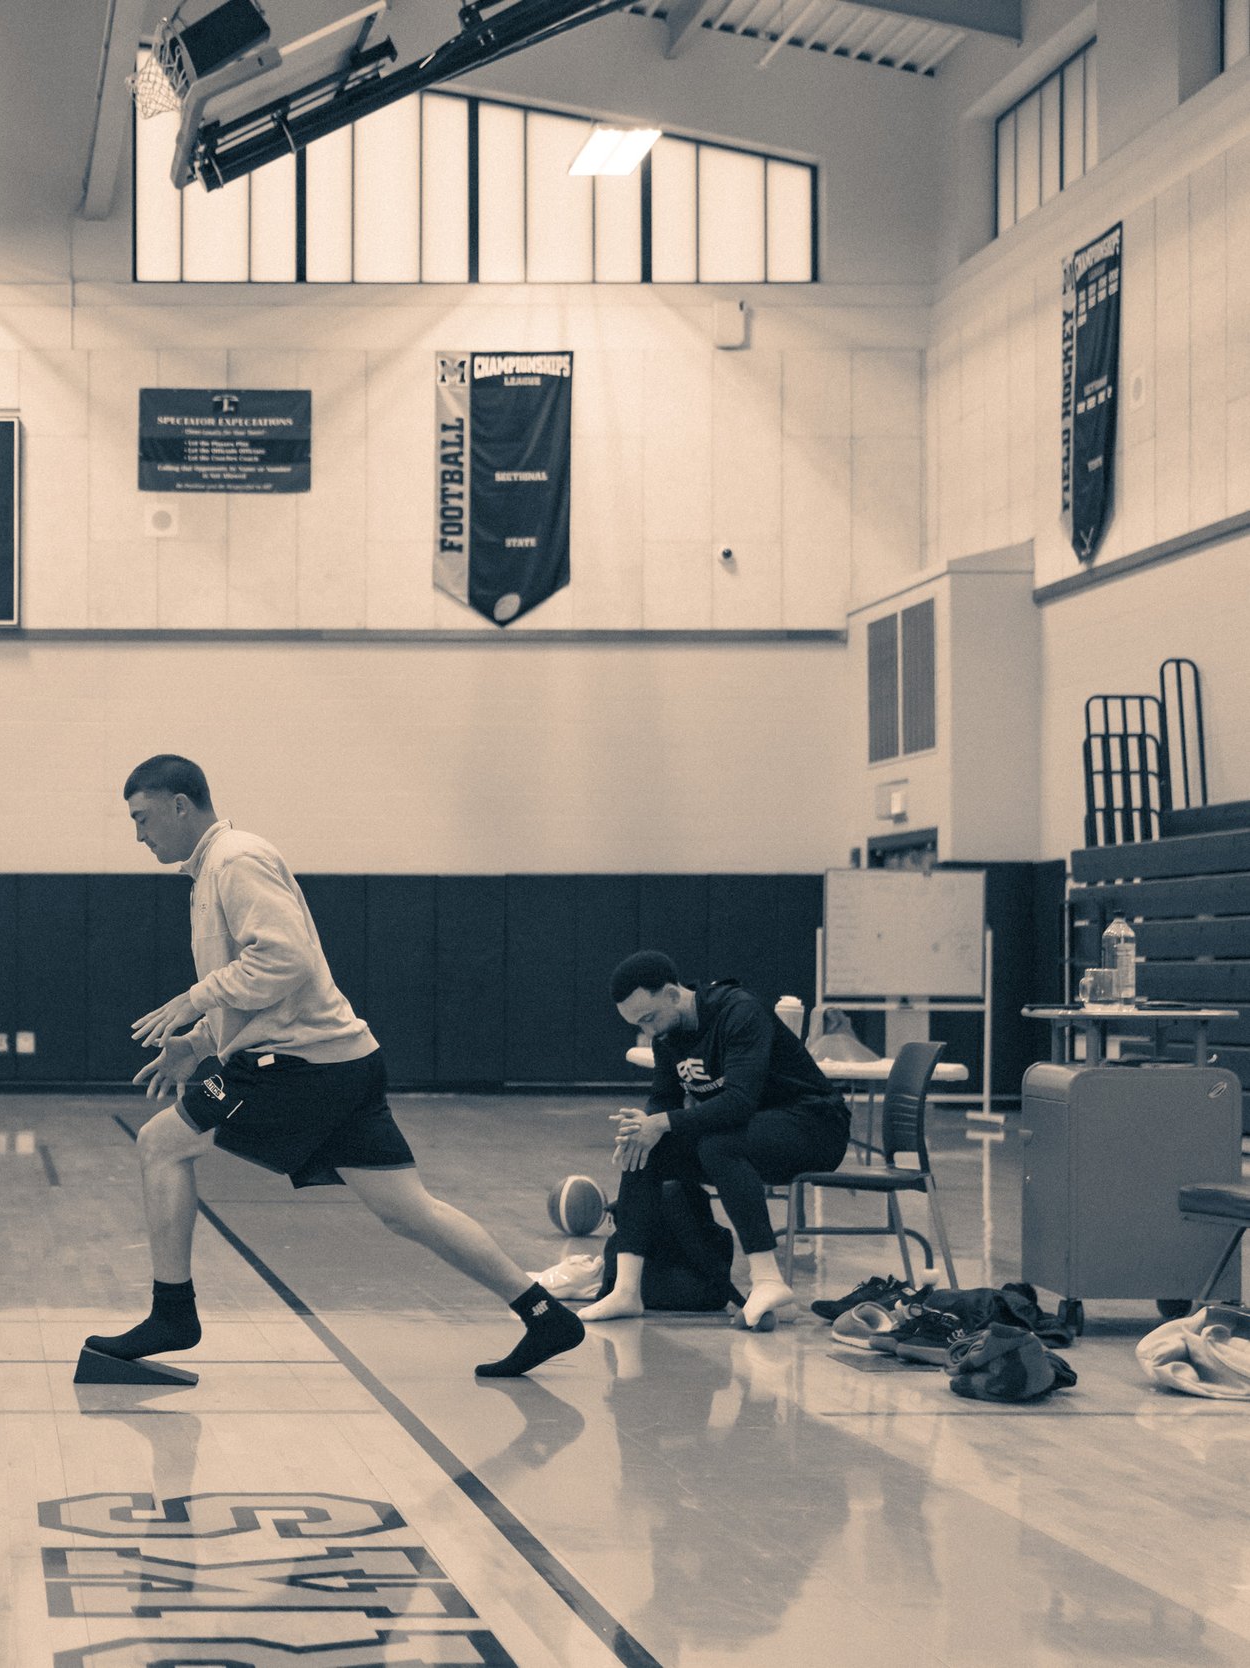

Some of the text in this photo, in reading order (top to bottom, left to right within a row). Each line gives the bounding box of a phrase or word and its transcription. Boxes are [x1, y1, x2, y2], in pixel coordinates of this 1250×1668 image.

[473, 354, 571, 380] CHAMPIONSHIPS
[157, 416, 294, 427] SPECTATOR EXPECTATIONS
[440, 417, 464, 553] FOOTBALL
[505, 537, 537, 548] STATE
